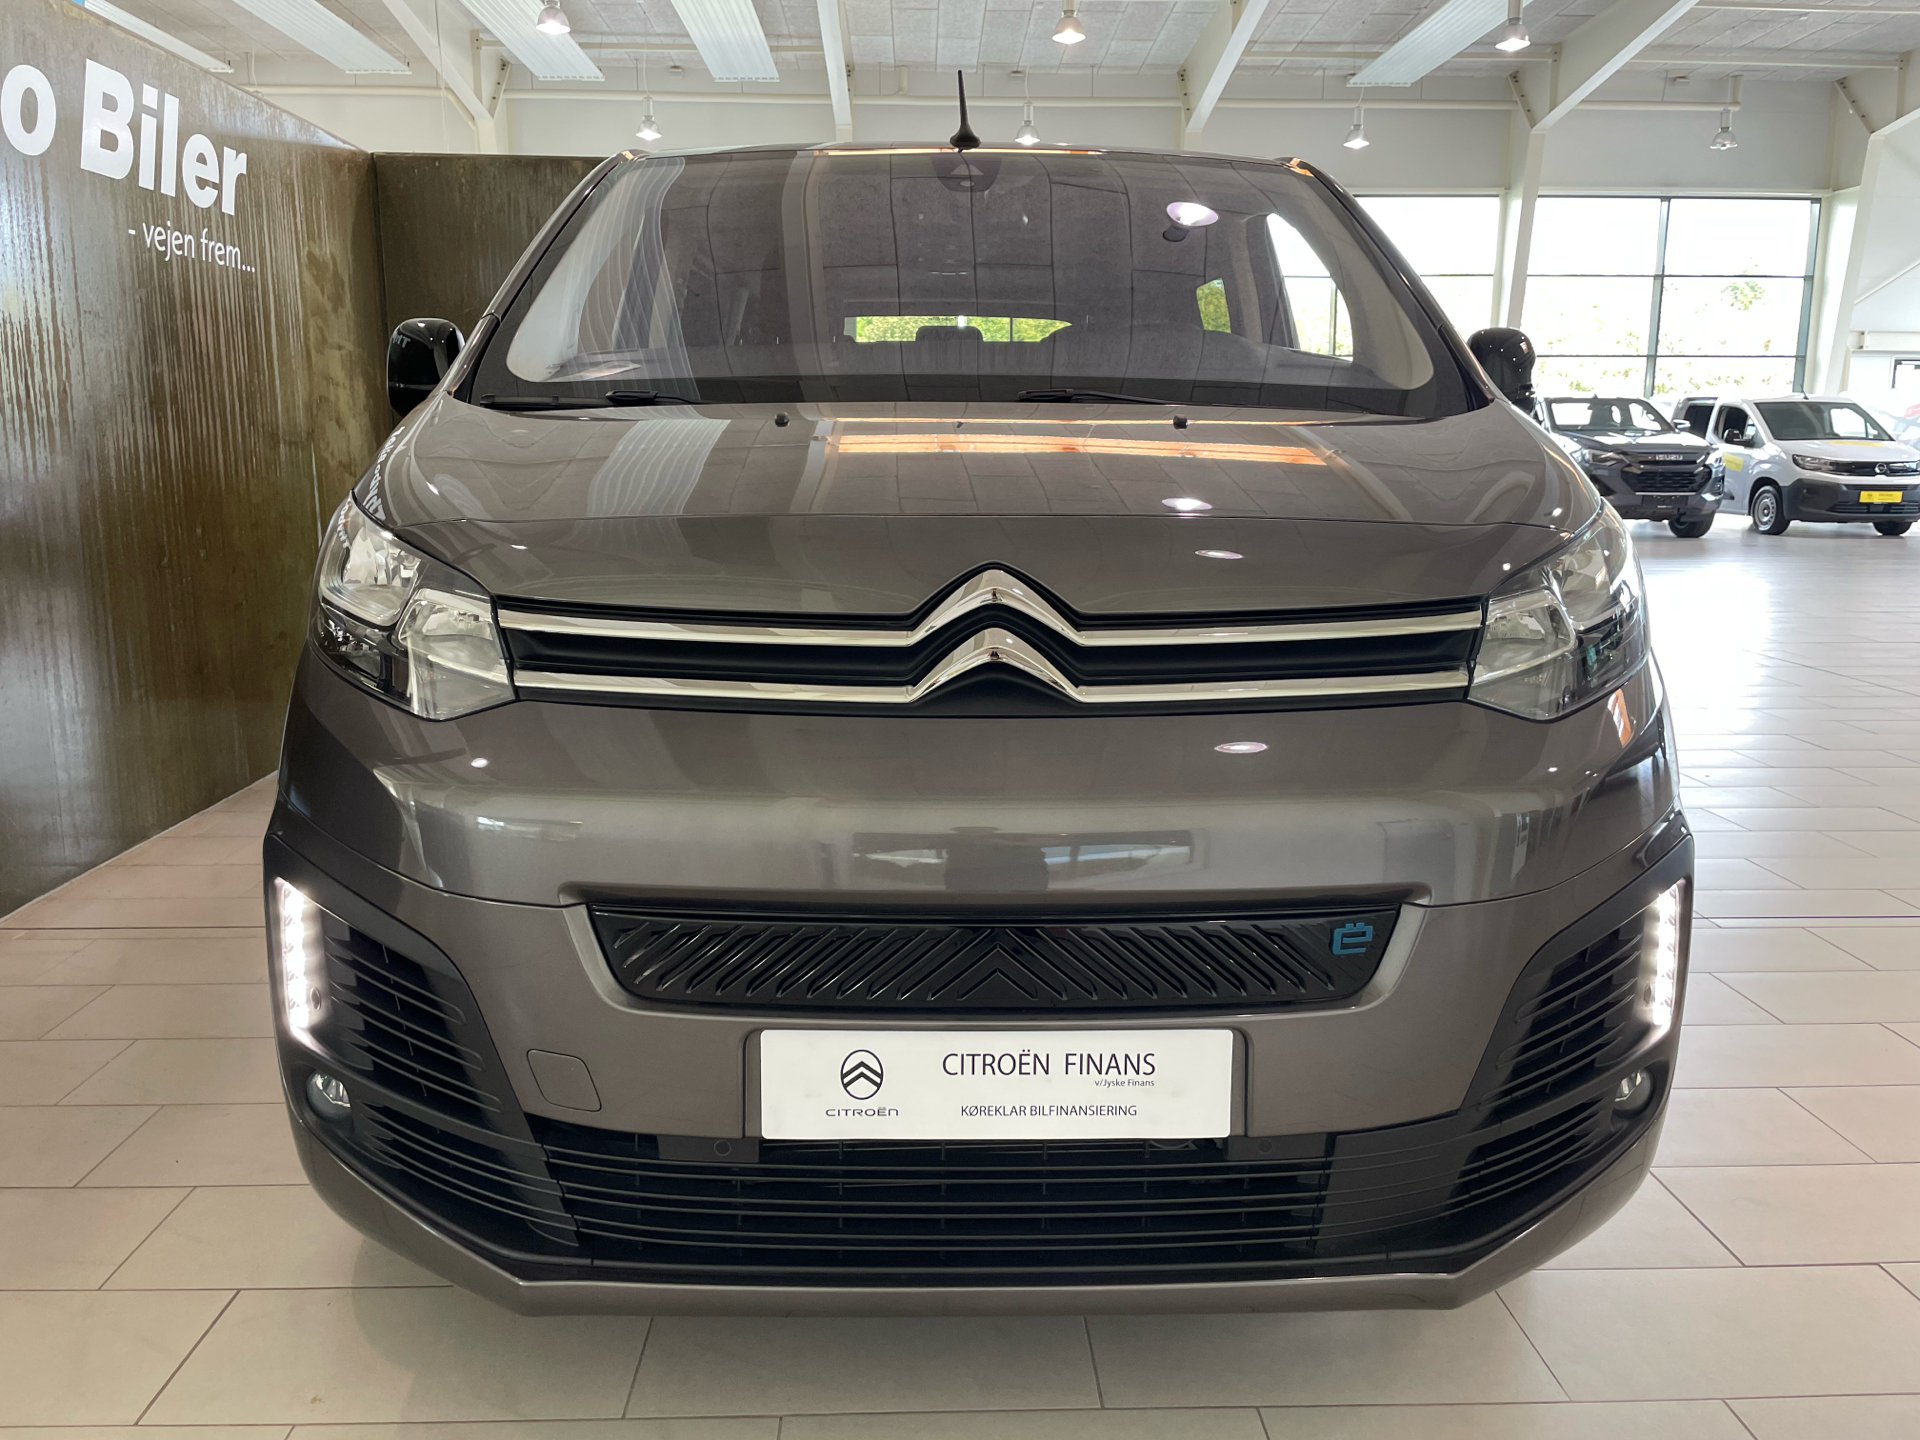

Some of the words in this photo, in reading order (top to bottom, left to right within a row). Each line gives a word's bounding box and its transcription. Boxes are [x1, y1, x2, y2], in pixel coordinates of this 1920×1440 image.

[80, 58, 248, 216] Biler
[142, 220, 195, 262] vejen
[200, 227, 256, 273] frem...
[942, 1048, 1050, 1076] CITROËN
[1065, 1052, 1156, 1076] FINANS
[1094, 1078, 1125, 1089] v/Jyske
[1127, 1078, 1155, 1088] Finans
[961, 1105, 1027, 1117] KØREKLAR
[1029, 1105, 1137, 1117] BILFINANSIERING
